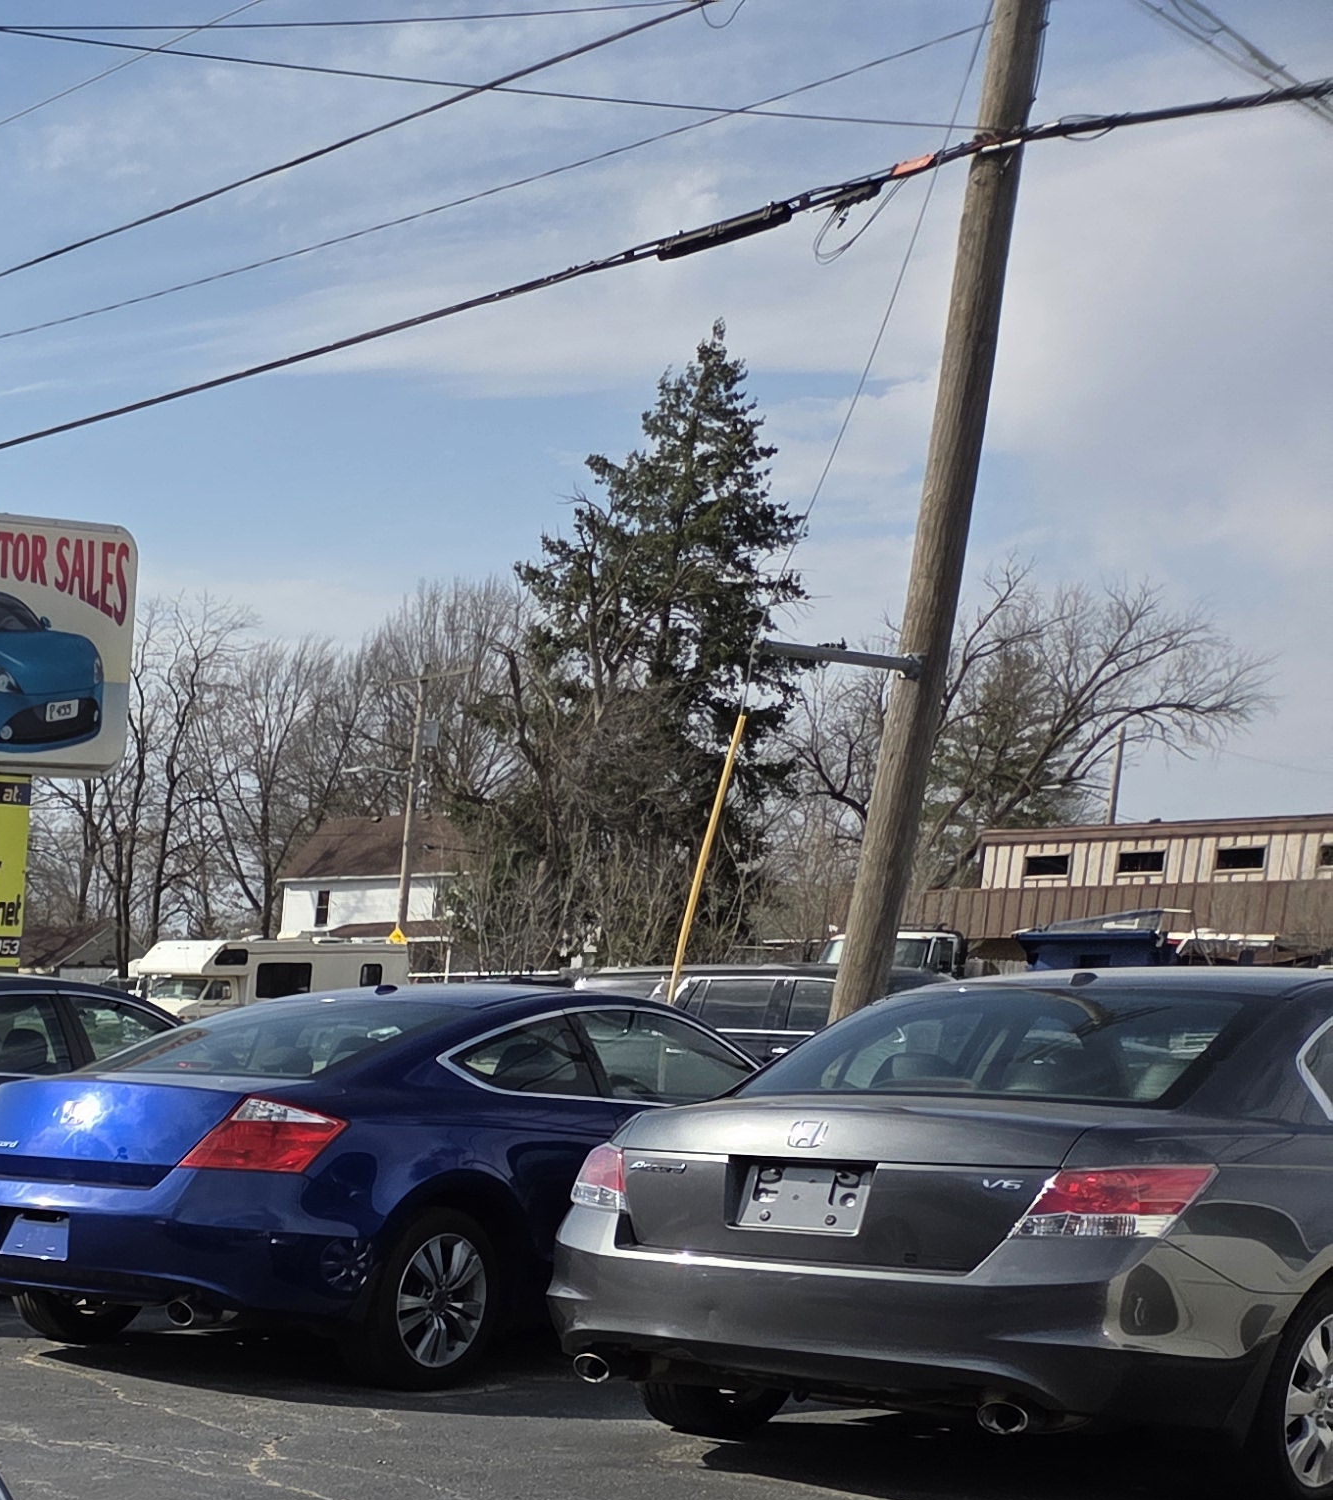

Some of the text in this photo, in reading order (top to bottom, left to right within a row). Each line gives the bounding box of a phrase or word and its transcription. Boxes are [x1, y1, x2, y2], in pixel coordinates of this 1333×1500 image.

[54, 537, 129, 627] SALES
[629, 1160, 687, 1174] Accord
[983, 1179, 1024, 1189] V6
